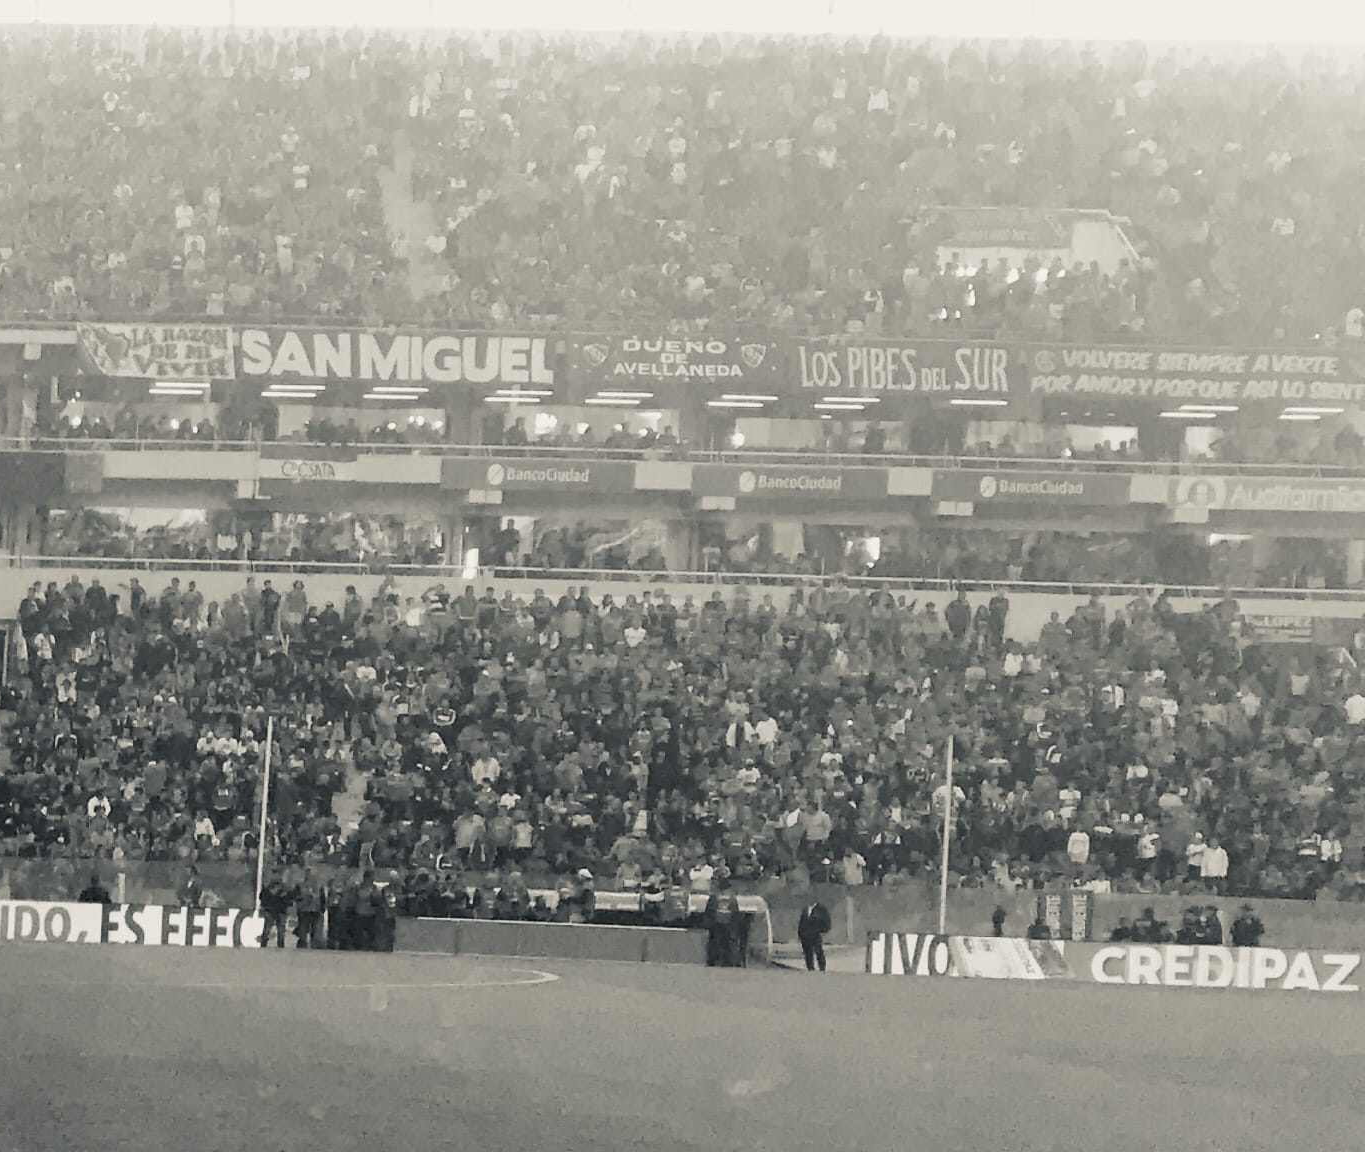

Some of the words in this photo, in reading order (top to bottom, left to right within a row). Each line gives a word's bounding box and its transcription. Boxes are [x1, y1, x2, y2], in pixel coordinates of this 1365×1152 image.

[241, 329, 352, 379] SAN
[359, 332, 554, 384] MIGUEL
[613, 363, 744, 378] AVELLANEDA
[660, 353, 689, 365] DE
[799, 345, 842, 388] LOS
[847, 347, 918, 391] PIBES
[920, 367, 951, 391] DEL
[955, 347, 1009, 392] SUR
[1062, 349, 1153, 371] VOLVERE
[1030, 375, 1073, 393] POR
[1074, 374, 1136, 395] AMOR
[102, 903, 146, 944] ES
[1091, 944, 1361, 991] CREDIPAZ
